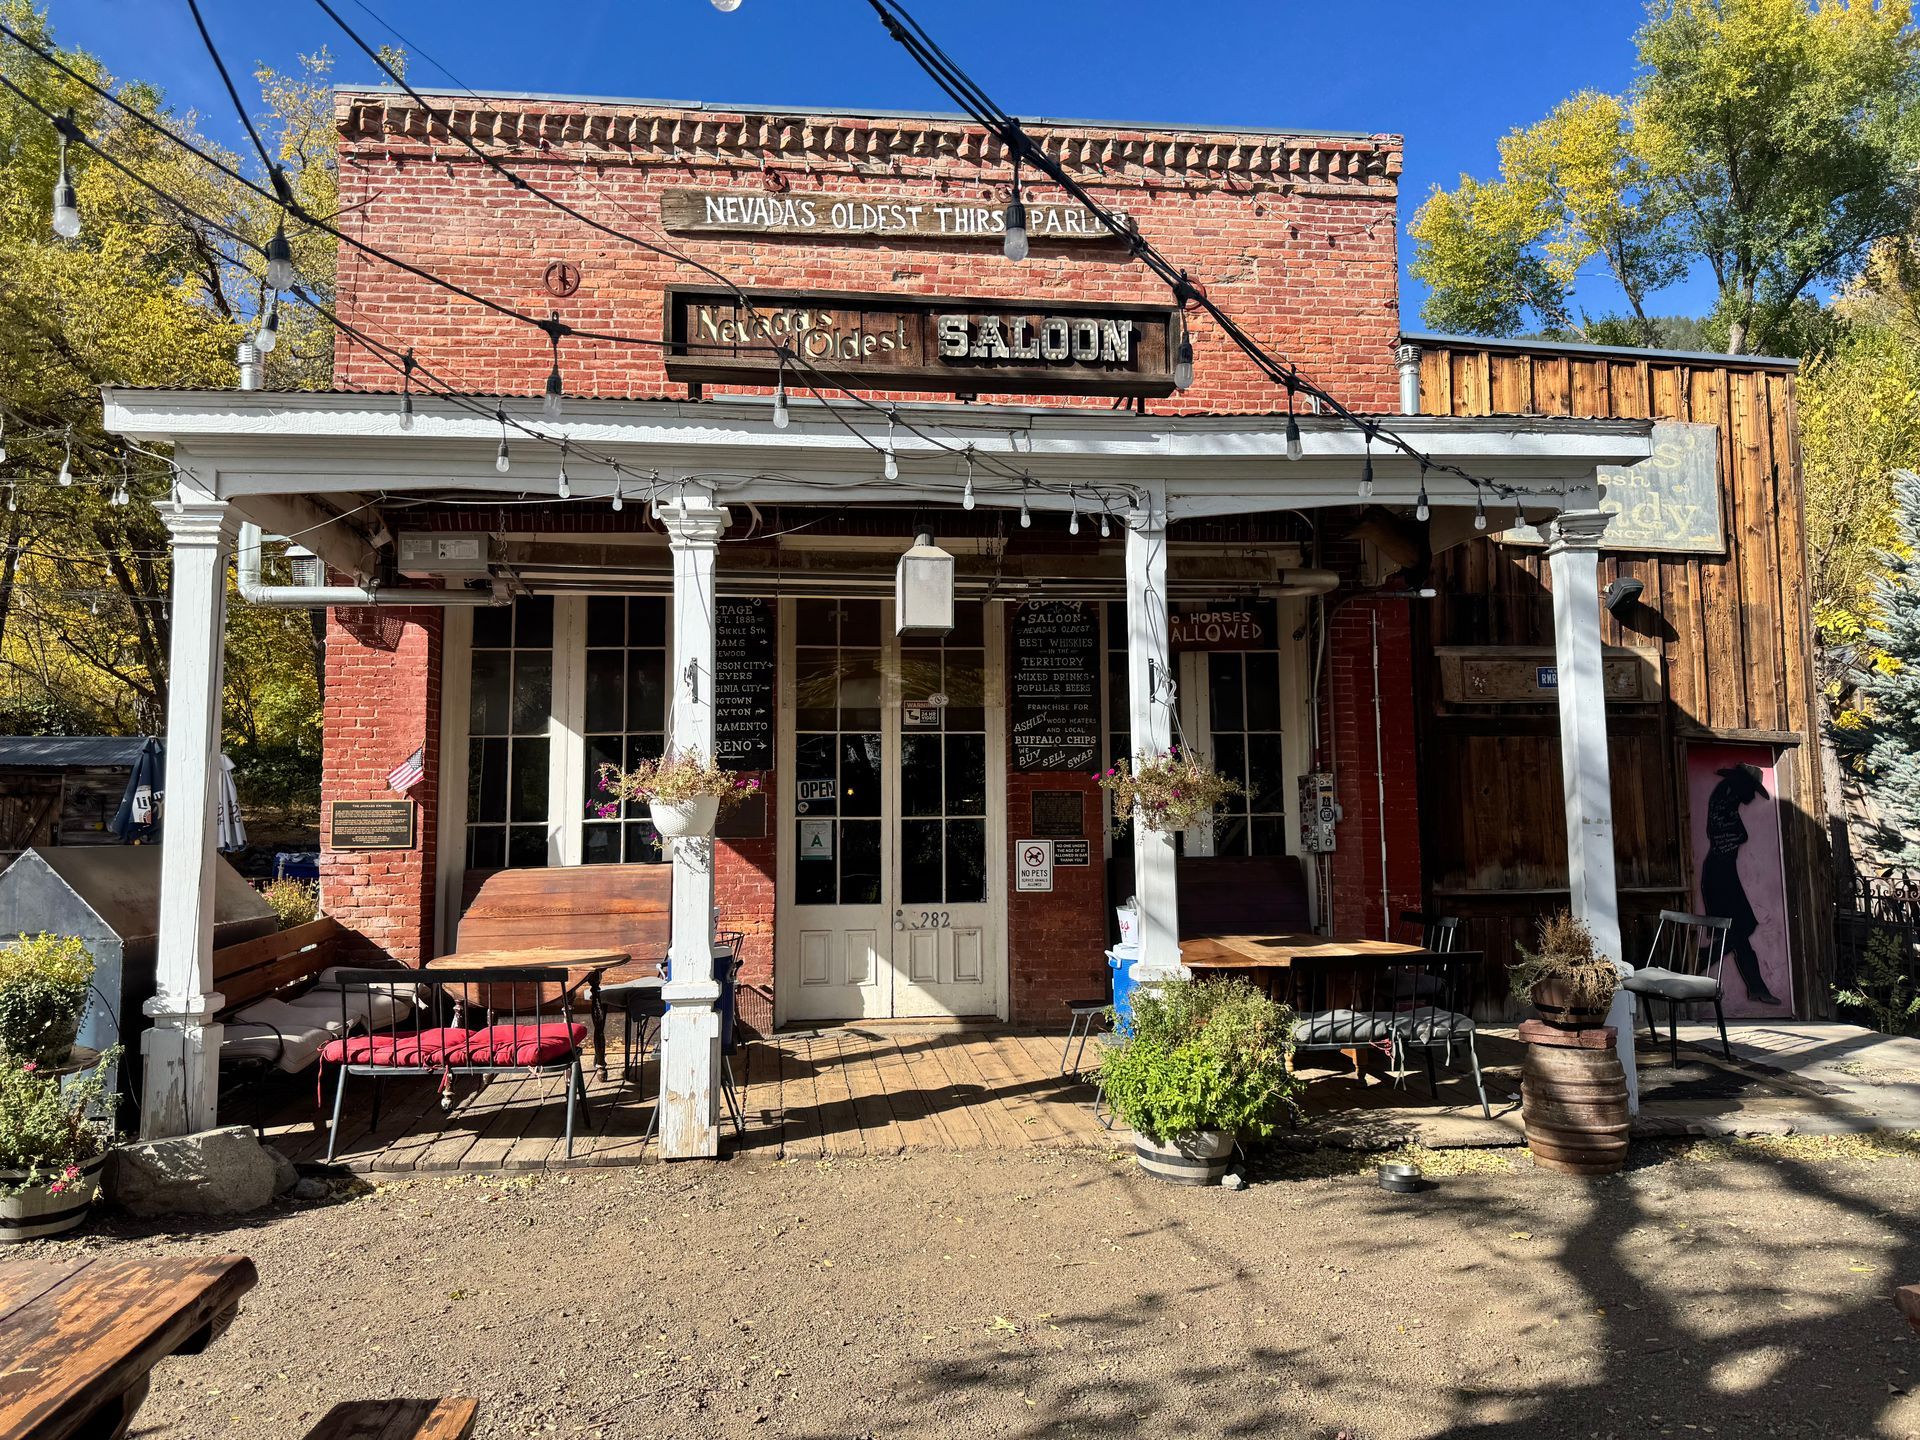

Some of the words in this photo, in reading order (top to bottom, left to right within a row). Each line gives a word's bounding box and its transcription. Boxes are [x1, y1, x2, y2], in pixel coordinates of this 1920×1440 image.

[704, 196, 816, 227] NEVADA'S
[831, 202, 926, 230] OLDEST
[934, 207, 1005, 233] THIRS
[803, 315, 911, 360] Oldest
[938, 314, 1133, 362] SALOON
[1598, 469, 1651, 488] esh
[715, 616, 731, 624] ST.
[1028, 613, 1081, 624] SALOON
[1190, 612, 1251, 624] HORSES
[1171, 623, 1262, 642] ALLOWED
[716, 639, 745, 647] DAMS
[1019, 638, 1043, 647] BEST
[1050, 638, 1093, 648] WHISKIES
[716, 661, 741, 670] RSON
[743, 661, 767, 670] CITY
[1021, 656, 1084, 667] TERRITORY
[1018, 673, 1048, 681] MIXED
[1053, 673, 1089, 681] DRINKS
[715, 685, 740, 693] GINIA
[741, 684, 761, 692] CITY
[1017, 684, 1060, 692] POPULAR
[1065, 683, 1091, 692] BEERS
[715, 697, 753, 705] NGTOWN
[716, 708, 752, 717] AYTON
[716, 722, 768, 732] RAMENTO
[1013, 711, 1048, 733] ASHLEY
[1014, 735, 1062, 745] BUFFALO
[1066, 735, 1097, 744] CHIPS
[1019, 748, 1041, 766] BUY
[1042, 750, 1066, 767] SELL
[1067, 749, 1093, 768] SWAP
[800, 781, 836, 799] OPEN
[811, 834, 823, 848] A
[1021, 869, 1030, 877] NO
[1032, 869, 1048, 877] PETS
[921, 911, 950, 928] 282
